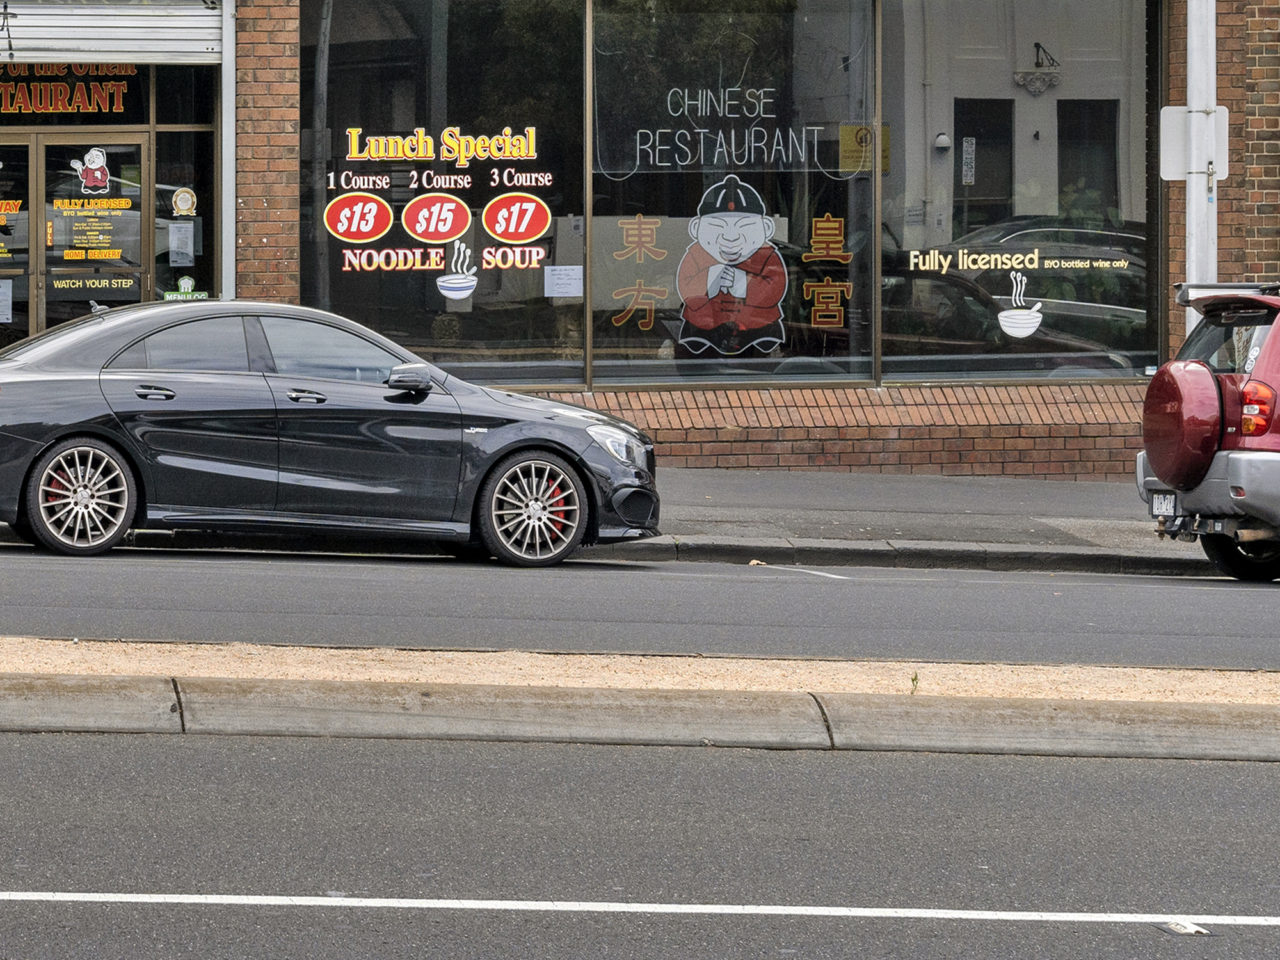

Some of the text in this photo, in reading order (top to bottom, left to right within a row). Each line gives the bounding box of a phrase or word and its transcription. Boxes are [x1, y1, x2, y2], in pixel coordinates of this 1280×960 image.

[667, 88, 776, 118] CHINESE
[346, 126, 537, 167] Lunch Special
[636, 126, 825, 166] RESTAURANT
[327, 171, 390, 189] 1 Course
[409, 171, 472, 189] 2 Course
[490, 168, 553, 187] 3 Course
[53, 198, 132, 209] FULLY LICENSED
[337, 202, 378, 233] $13
[415, 202, 456, 233] $15
[494, 202, 536, 234] $17
[63, 249, 122, 259] HOME DELIVERY
[342, 247, 545, 271] NOODLE SOUP
[909, 248, 1129, 274] Fully licensed BYO bottled wine only
[53, 279, 133, 288] WATCH YOUR STEP
